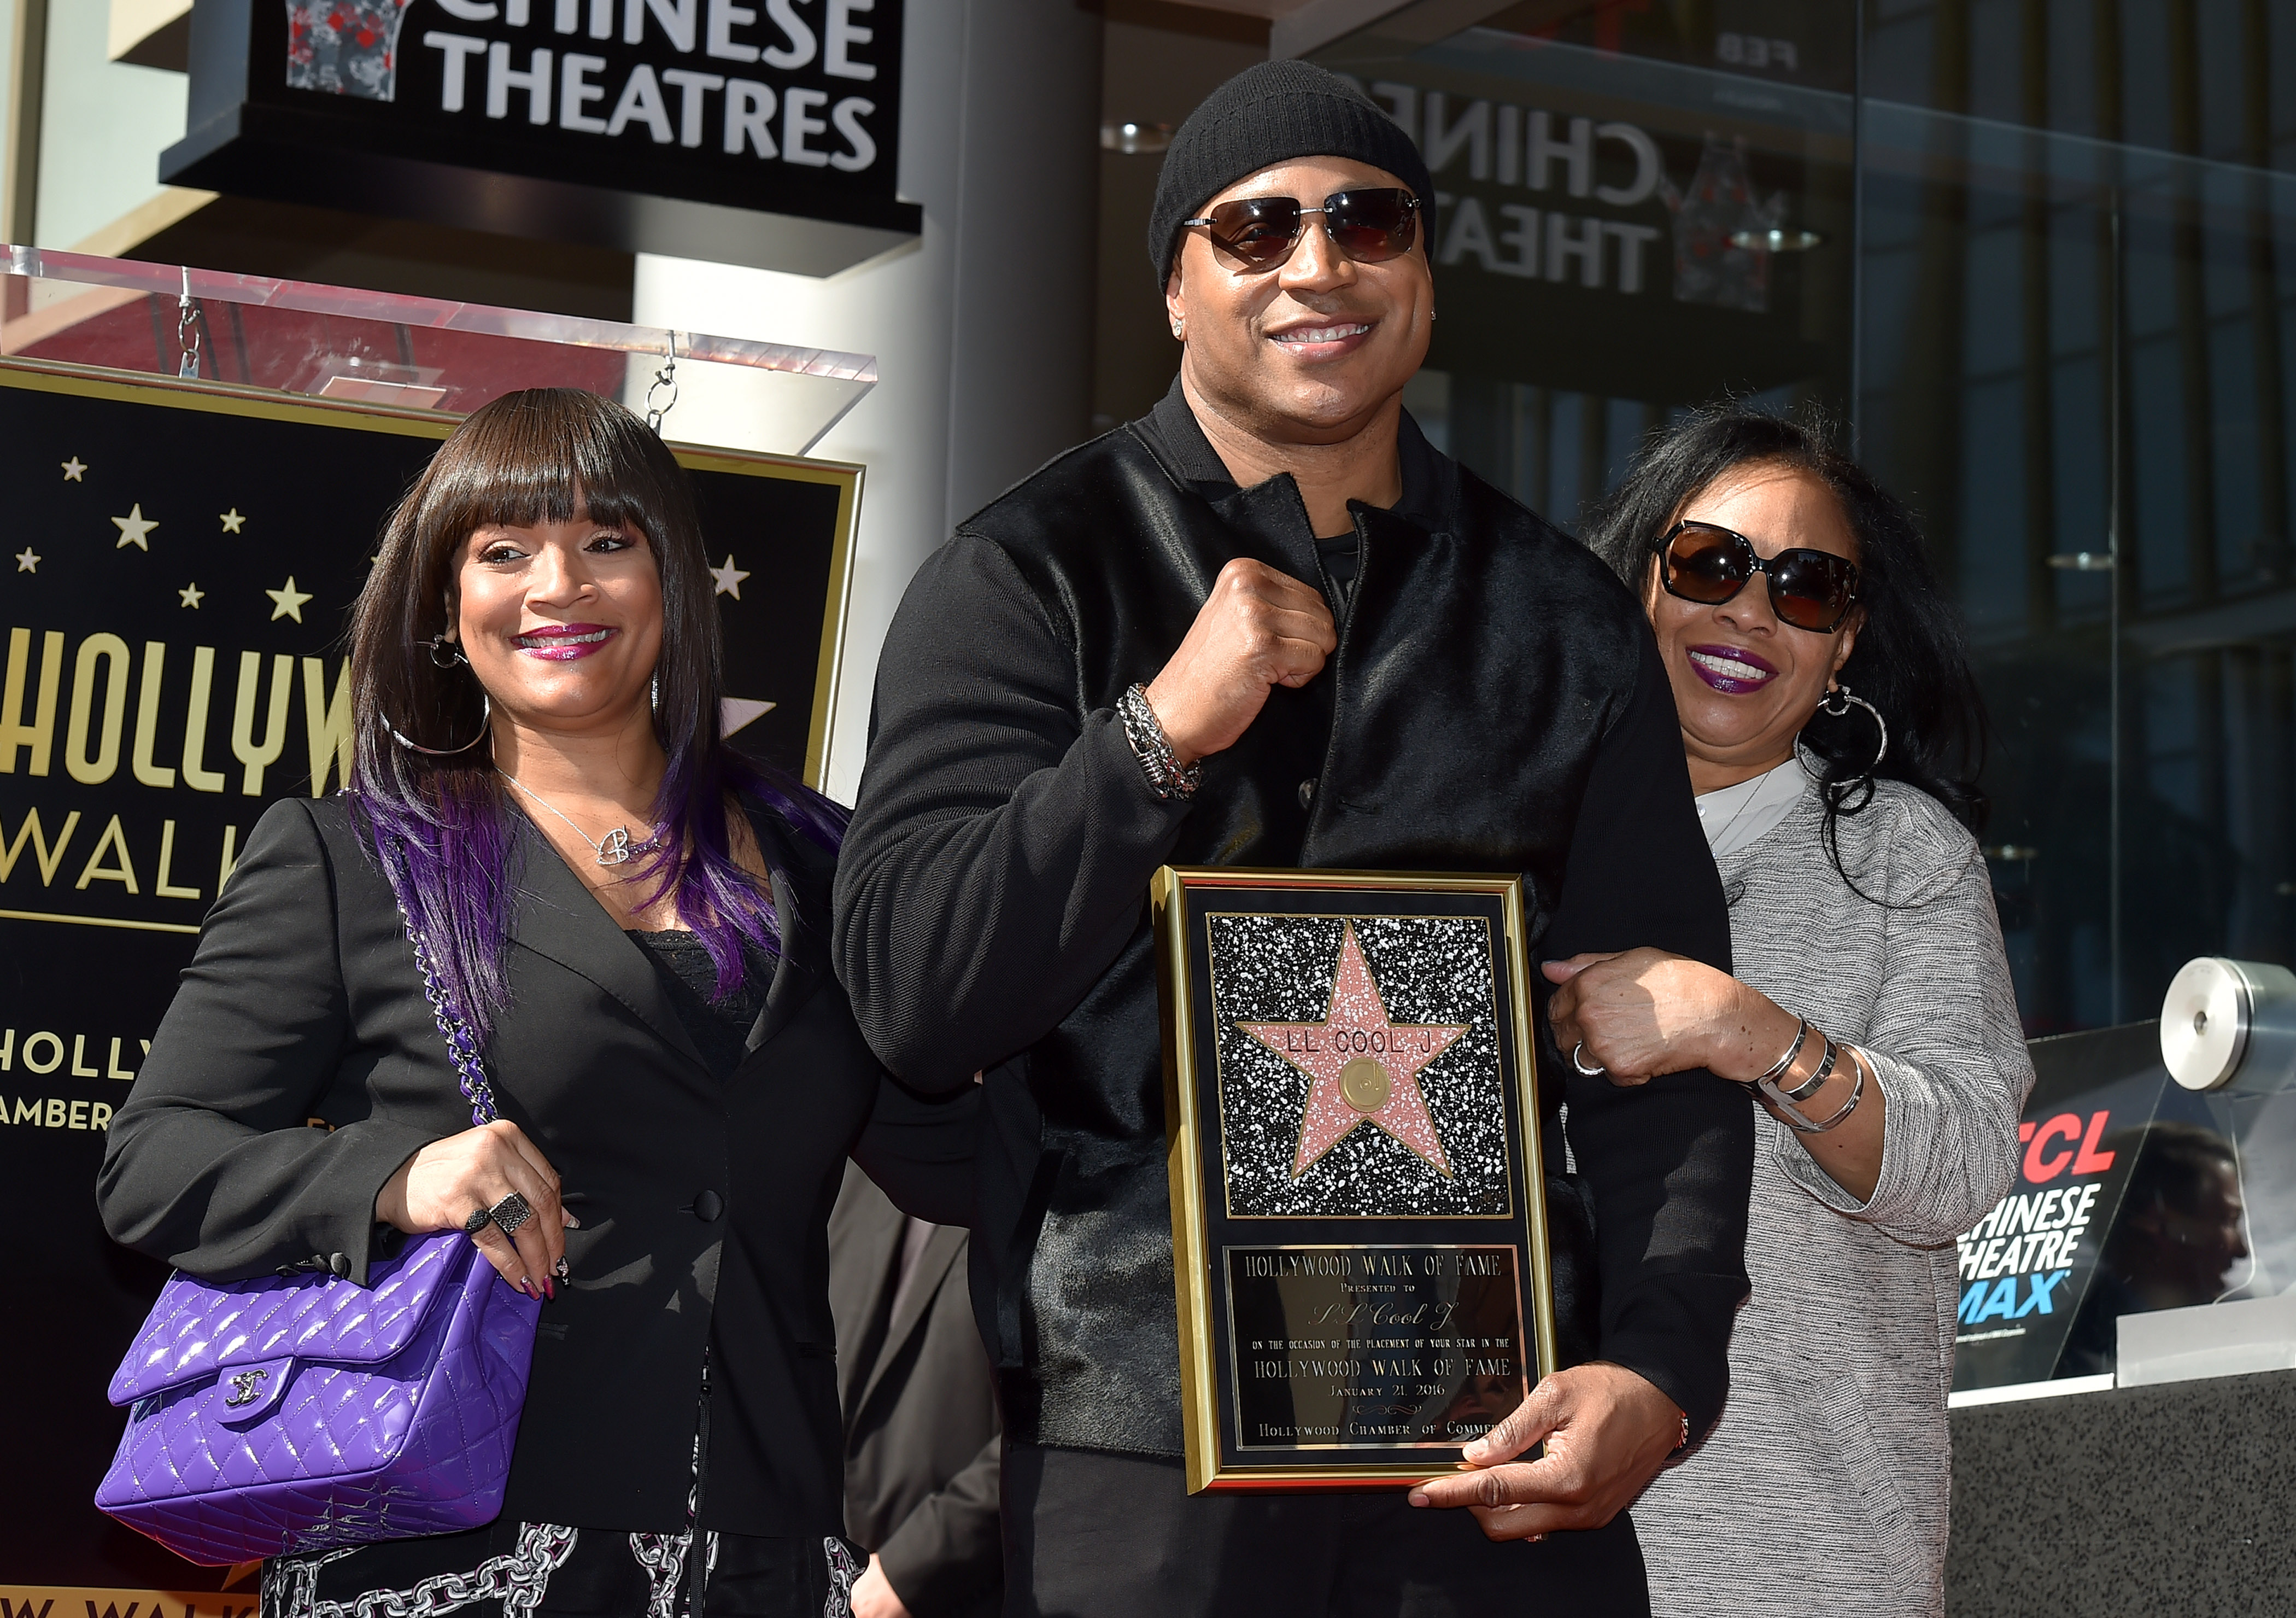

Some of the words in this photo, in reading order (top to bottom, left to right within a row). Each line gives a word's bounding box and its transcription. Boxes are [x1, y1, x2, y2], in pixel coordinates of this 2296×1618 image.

[423, 31, 876, 172] THEATRES
[1287, 1030, 1320, 1053] LL
[1335, 1030, 1404, 1053] COOL
[1420, 1031, 1431, 1053] J
[0, 1029, 151, 1080] HOLL
[1245, 1255, 1351, 1277] HOLLYWOOD
[1362, 1255, 1413, 1276] WALK
[1425, 1255, 1444, 1276] OF
[1455, 1255, 1501, 1276] FAME
[1369, 1302, 1427, 1325] Cool
[1430, 1302, 1459, 1330] J
[1252, 1341, 1262, 1350] ON
[1268, 1340, 1284, 1350] THE
[1289, 1340, 1325, 1350] OCCASION
[1331, 1340, 1340, 1349] OF
[1346, 1339, 1361, 1349] THE
[1367, 1339, 1409, 1348] PLACEMENT
[1415, 1339, 1424, 1348] OF
[1430, 1339, 1450, 1348] YOUR
[1456, 1339, 1475, 1348] STAR
[1481, 1338, 1490, 1347] IN
[1495, 1338, 1509, 1348] THE
[1255, 1360, 1361, 1378] HOLLYWOOD
[1372, 1359, 1422, 1376] WALK
[1434, 1358, 1454, 1376] OF
[1465, 1358, 1510, 1376] FAME
[1416, 1384, 1445, 1395] 2016
